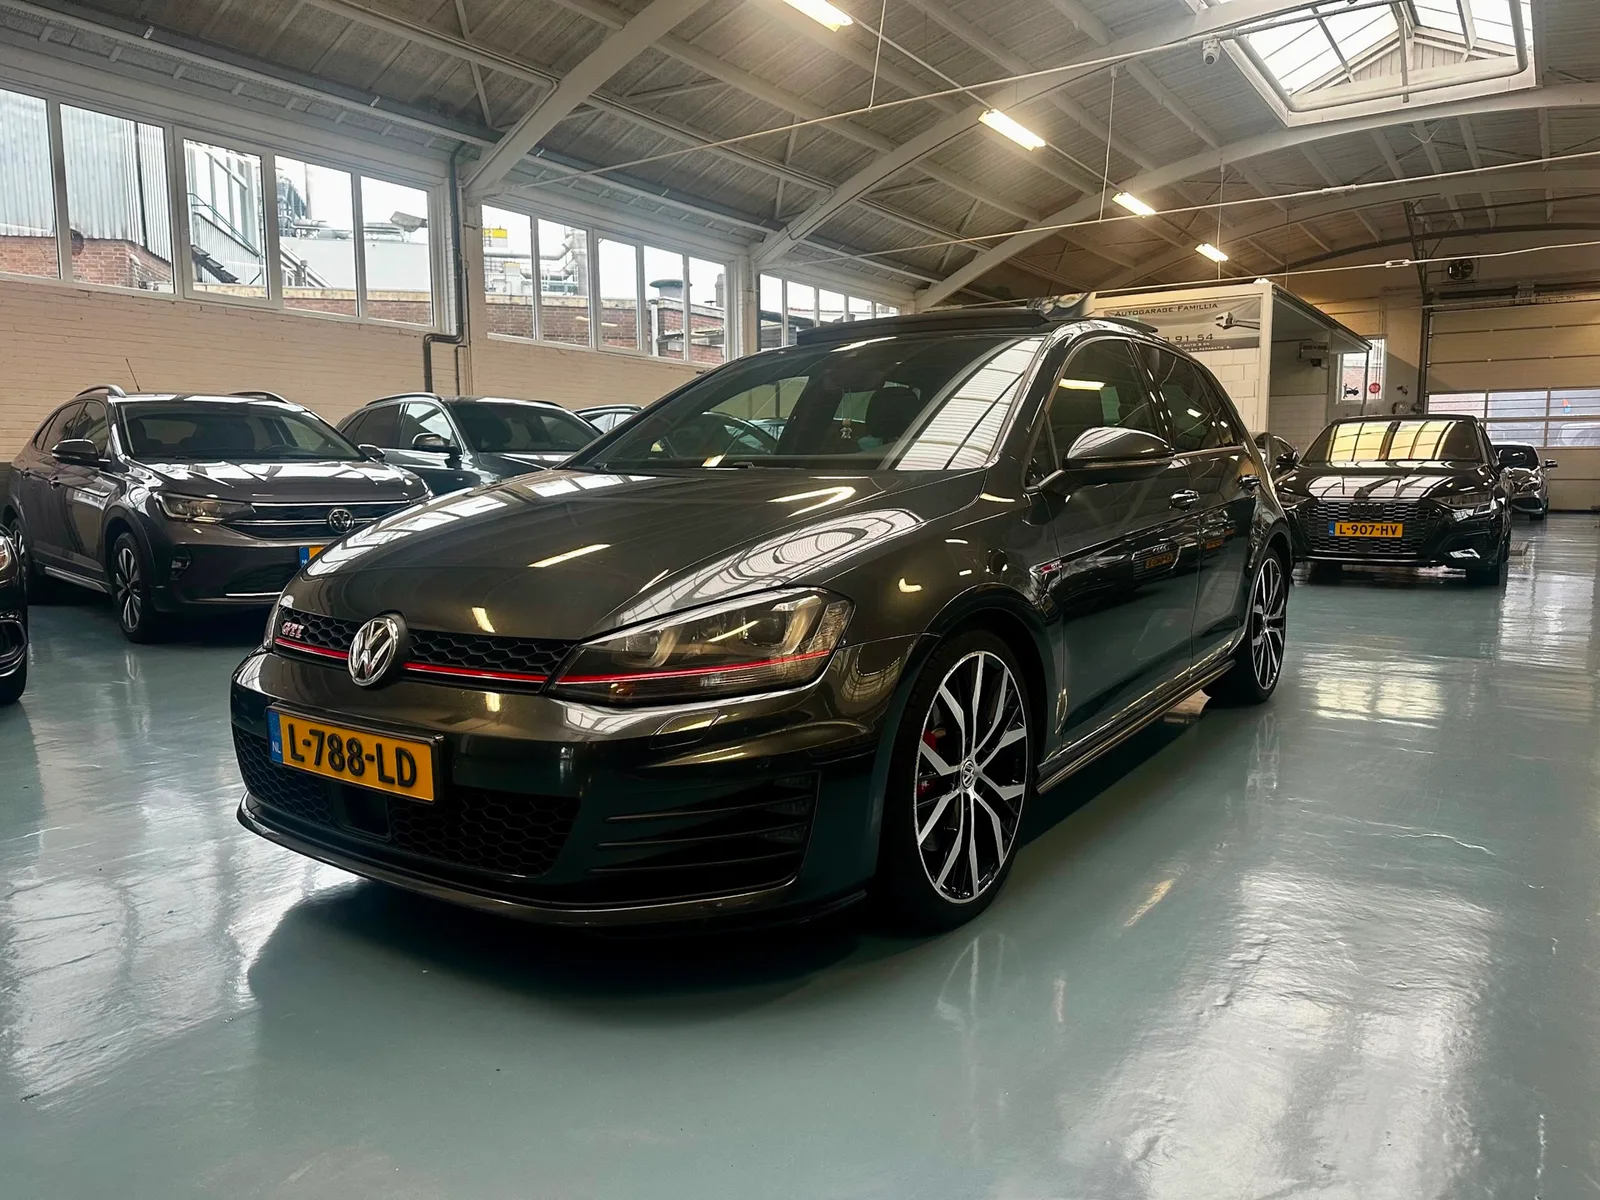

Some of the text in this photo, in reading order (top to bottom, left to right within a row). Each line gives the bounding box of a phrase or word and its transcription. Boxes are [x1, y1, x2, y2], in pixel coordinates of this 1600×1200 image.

[1197, 333, 1214, 342] 54
[1339, 524, 1398, 536] L-907-HV
[282, 621, 305, 639] GTI
[272, 723, 417, 788] NL L-788-LD
